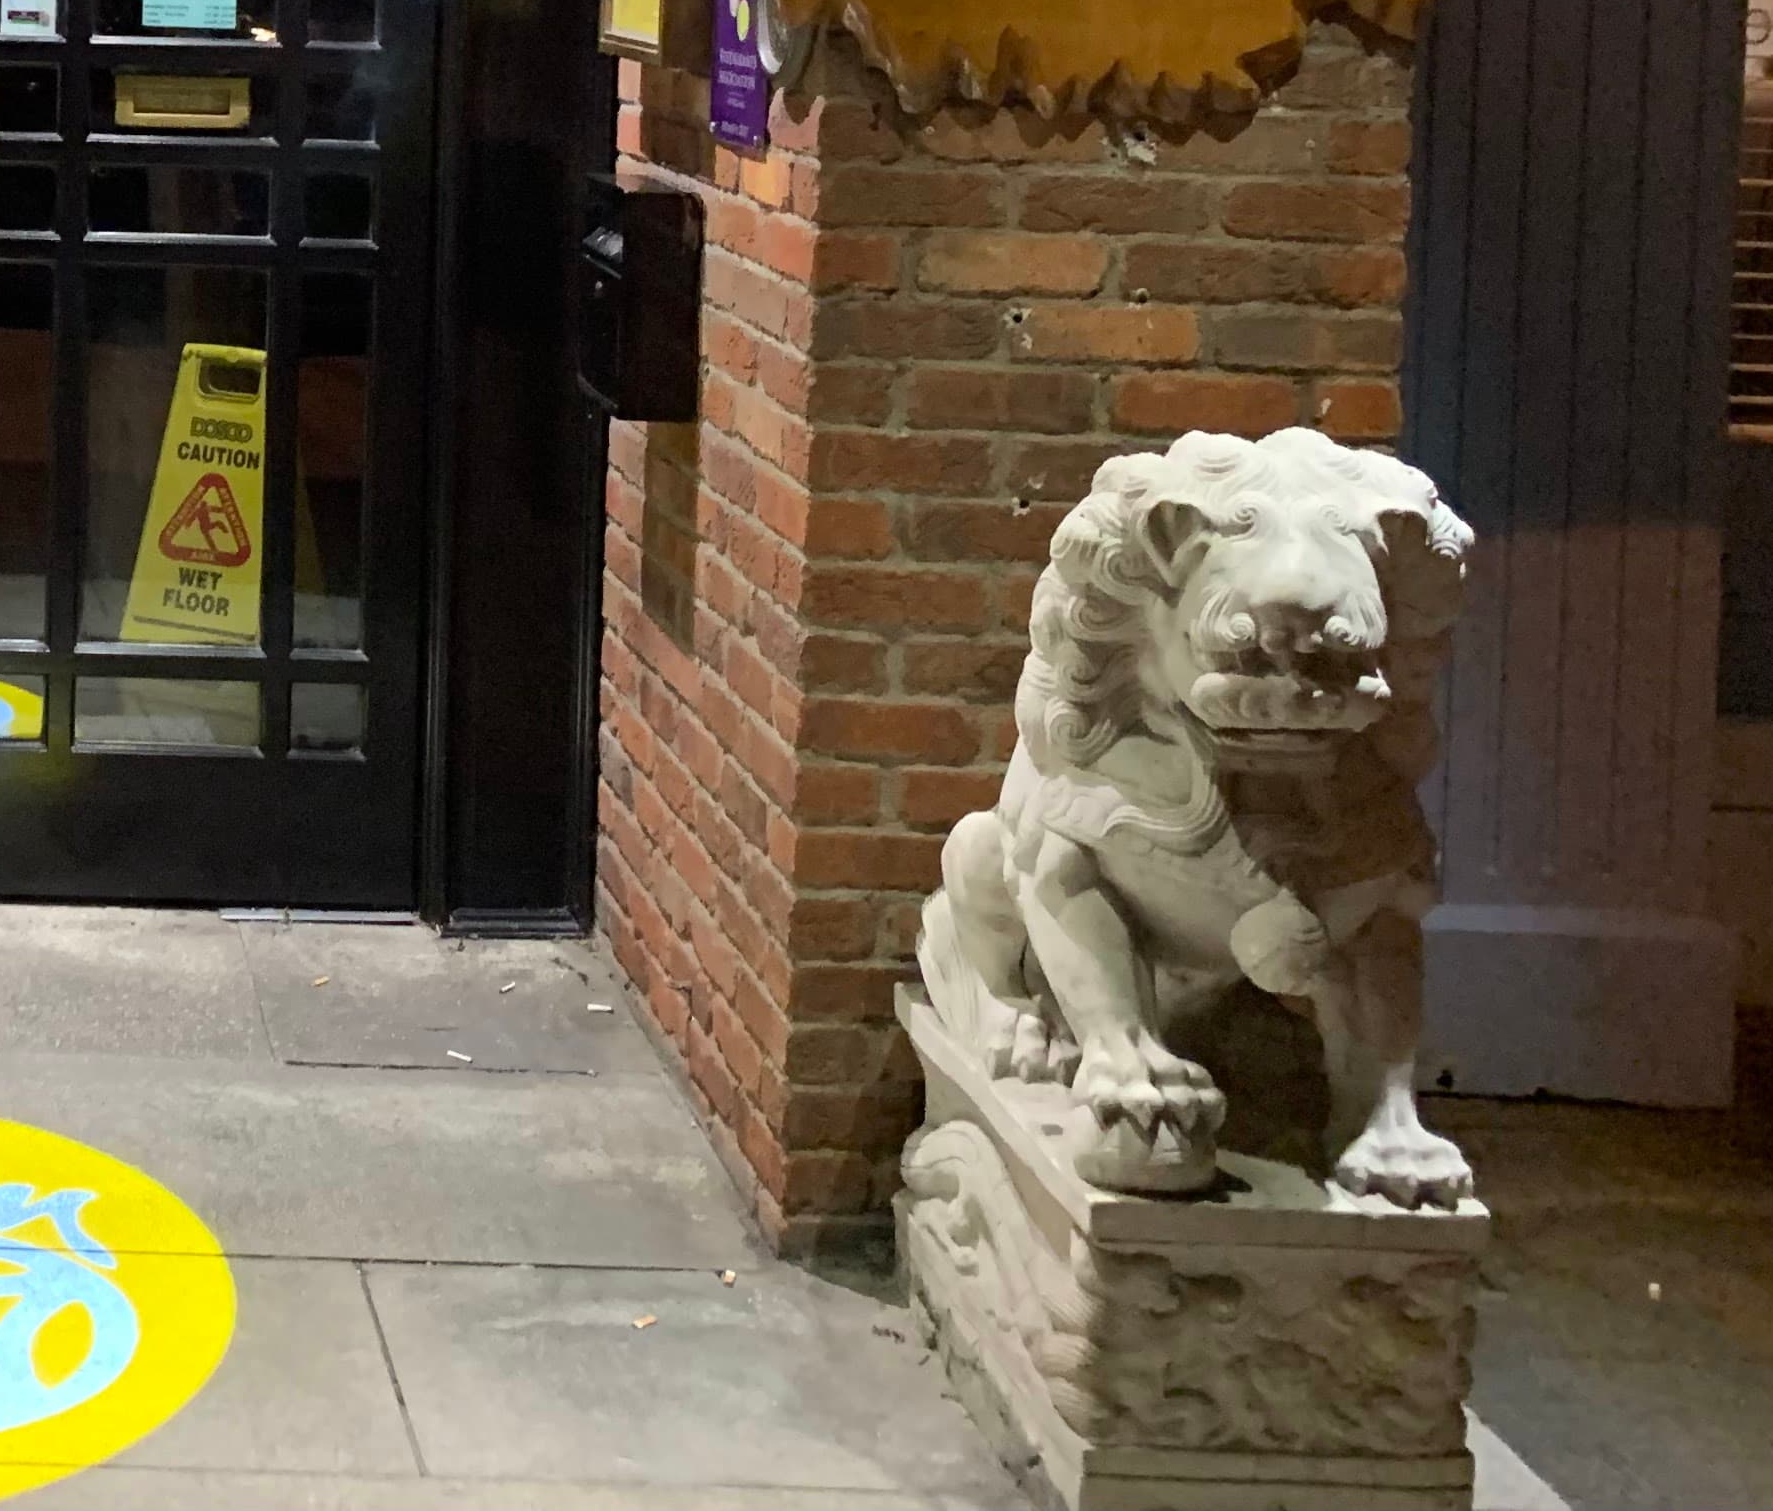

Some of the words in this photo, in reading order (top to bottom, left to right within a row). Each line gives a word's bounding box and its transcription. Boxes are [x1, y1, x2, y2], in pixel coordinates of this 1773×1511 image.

[177, 442, 260, 469] CAUTION
[178, 567, 222, 591] WET
[162, 589, 230, 616] FLOOR
